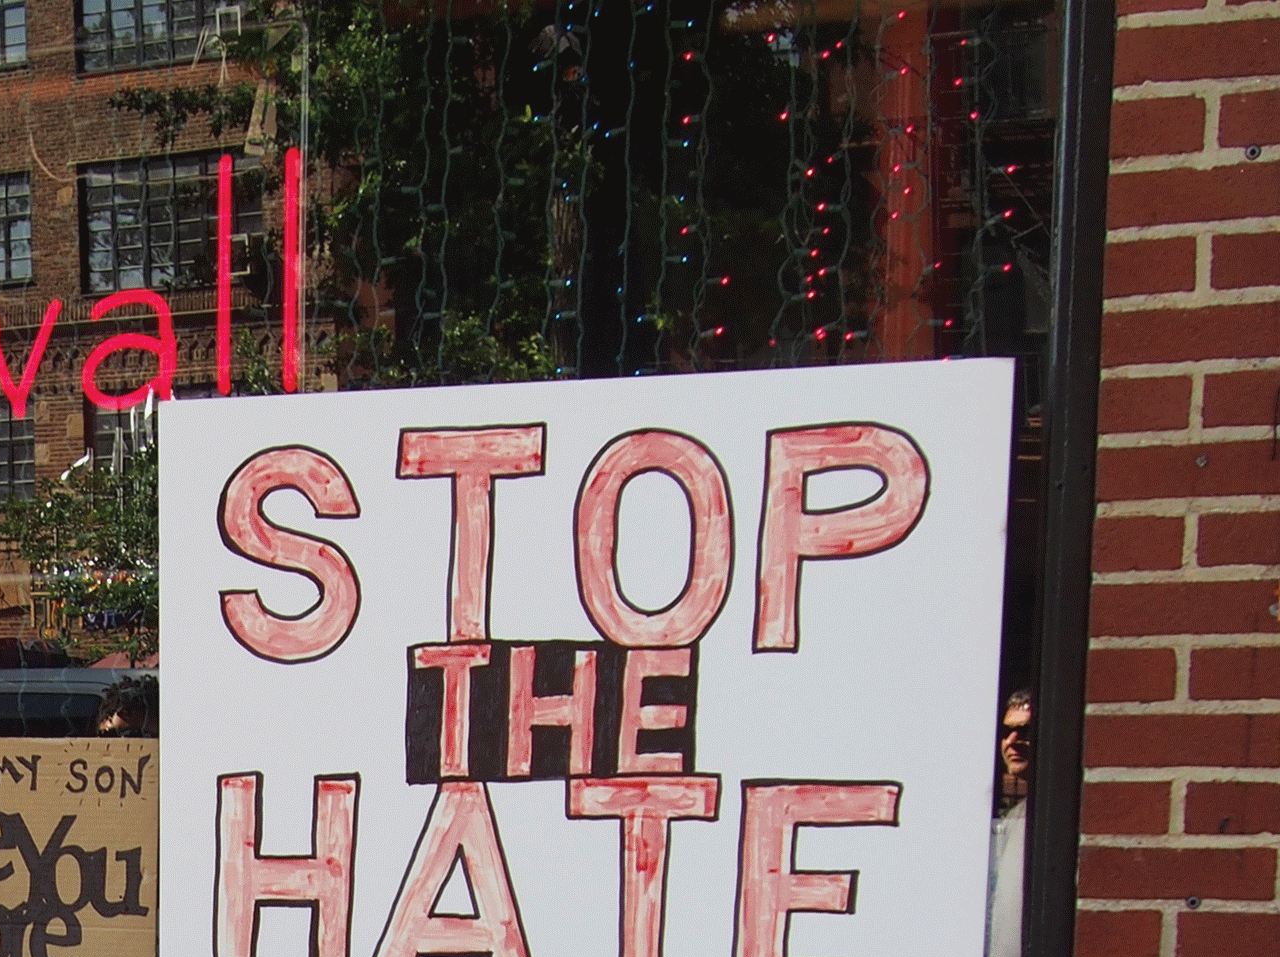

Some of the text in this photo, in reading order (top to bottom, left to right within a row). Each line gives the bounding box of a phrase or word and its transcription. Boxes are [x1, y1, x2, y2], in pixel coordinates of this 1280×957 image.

[217, 421, 933, 664] STOP
[411, 643, 695, 780] THE
[65, 753, 152, 799] SON
[14, 812, 150, 919] You
